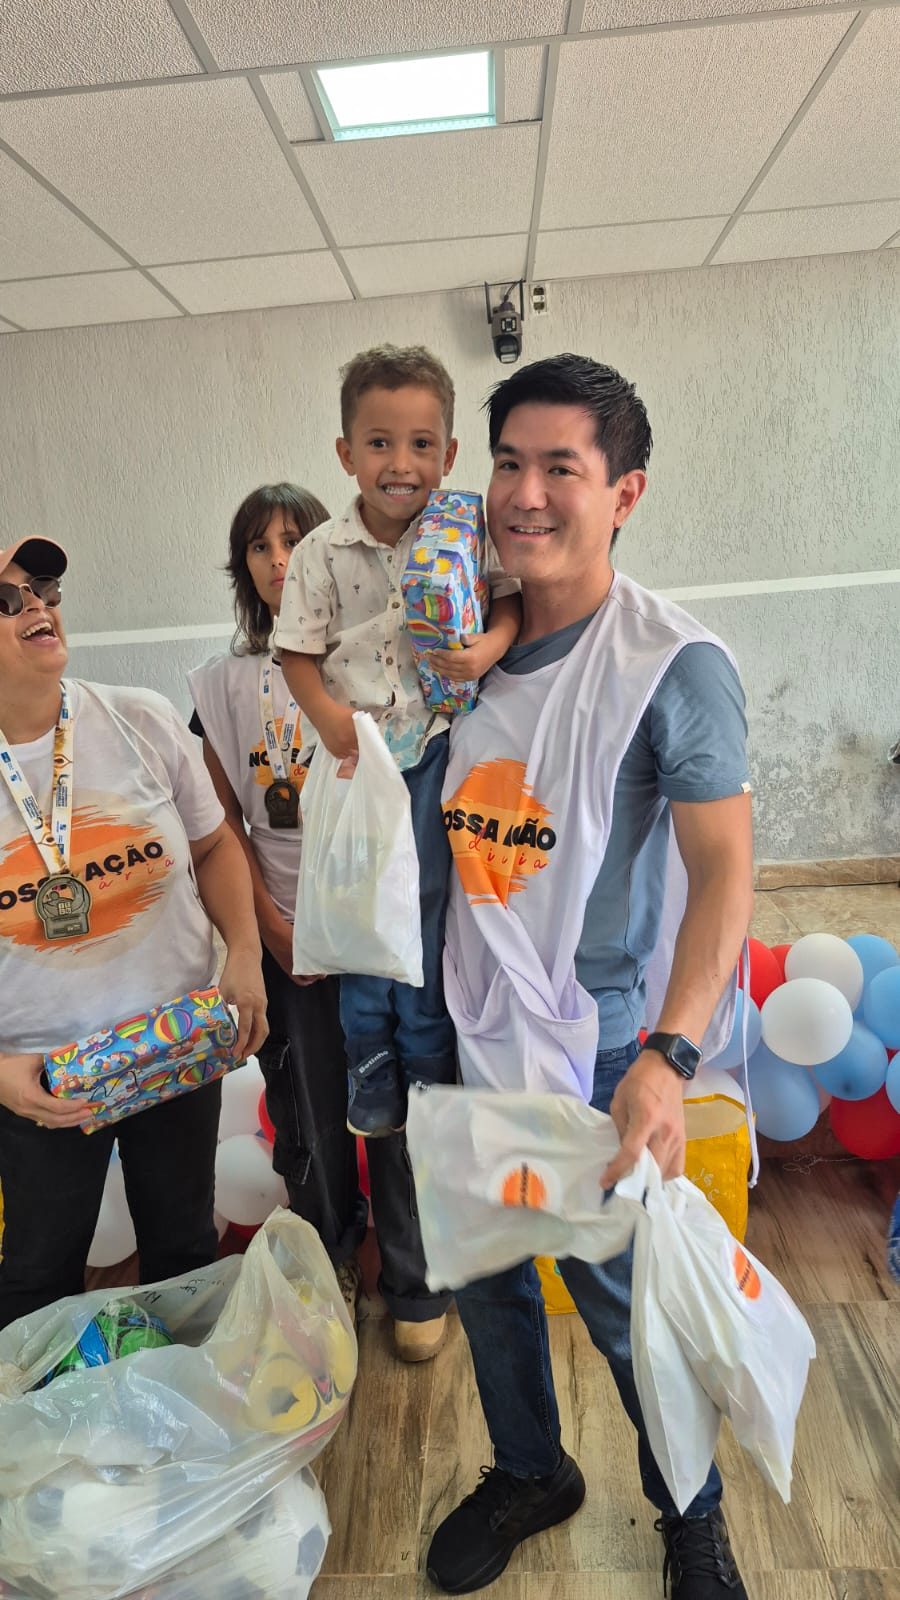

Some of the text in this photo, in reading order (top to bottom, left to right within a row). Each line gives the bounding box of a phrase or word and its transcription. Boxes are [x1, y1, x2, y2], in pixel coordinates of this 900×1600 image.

[85, 841, 164, 882] AÇÃO
[359, 1050, 389, 1074] Botinho
[415, 1080, 433, 1093] Bot
